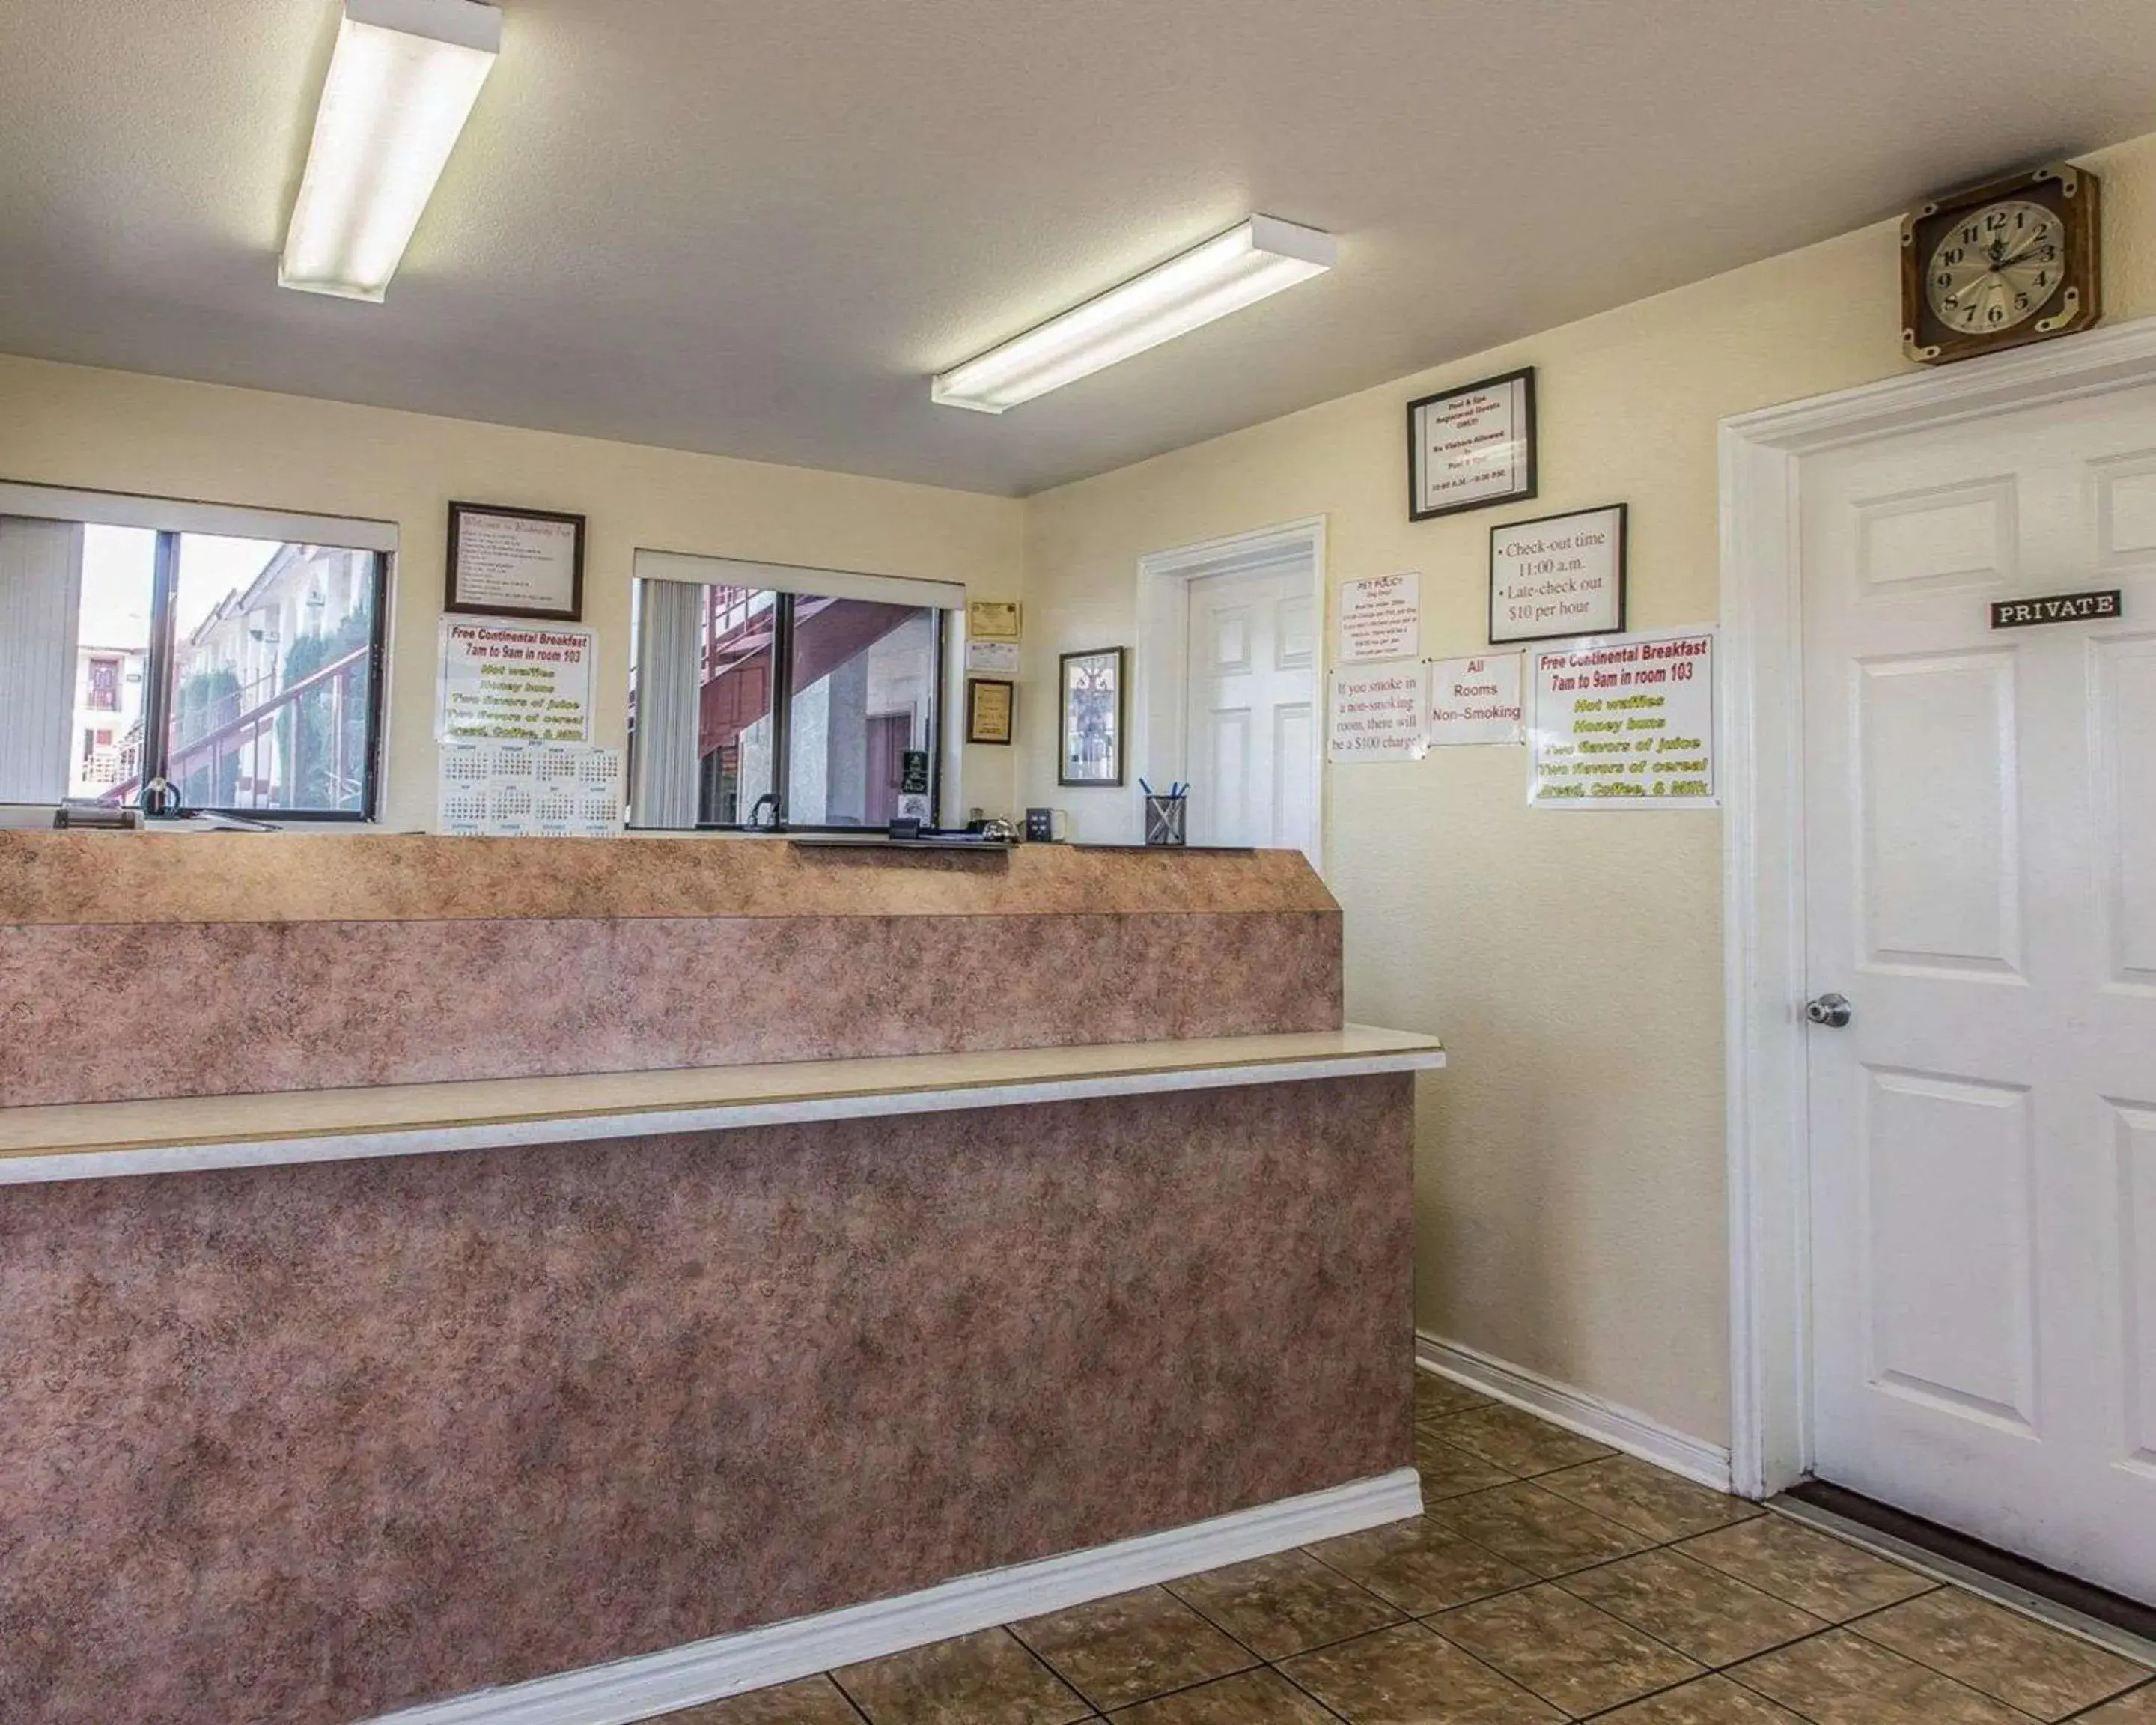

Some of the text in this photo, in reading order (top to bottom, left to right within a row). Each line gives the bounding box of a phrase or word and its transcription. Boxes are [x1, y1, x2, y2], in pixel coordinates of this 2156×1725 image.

[1985, 213, 2006, 231] 12
[2014, 213, 2023, 228] 1
[1962, 225, 1979, 244] 11
[2033, 224, 2047, 242] 2
[1943, 248, 1964, 266] 10
[1937, 273, 1952, 288] 9
[2032, 270, 2046, 288] 4
[2013, 293, 2028, 310] 5
[1964, 305, 1977, 322] 7
[1988, 305, 2003, 323] 6
[1506, 532, 1605, 558] Check-out time
[1520, 559, 1586, 576] 11:00 a.m.
[1508, 578, 1602, 599] Late-check out
[1509, 601, 1589, 621] $10 per hour
[2000, 595, 2113, 623] PRIVATE
[452, 627, 588, 647] Free Continental Breakfast
[466, 643, 581, 663] 7am to 9am in room 103
[1541, 640, 1707, 670] Free Continental Breakfast
[1467, 660, 1484, 672] All
[1552, 661, 1693, 691] 7am to 9am in room 103
[1454, 684, 1498, 697] Rooms
[1432, 705, 1520, 720] Non-Smoking
